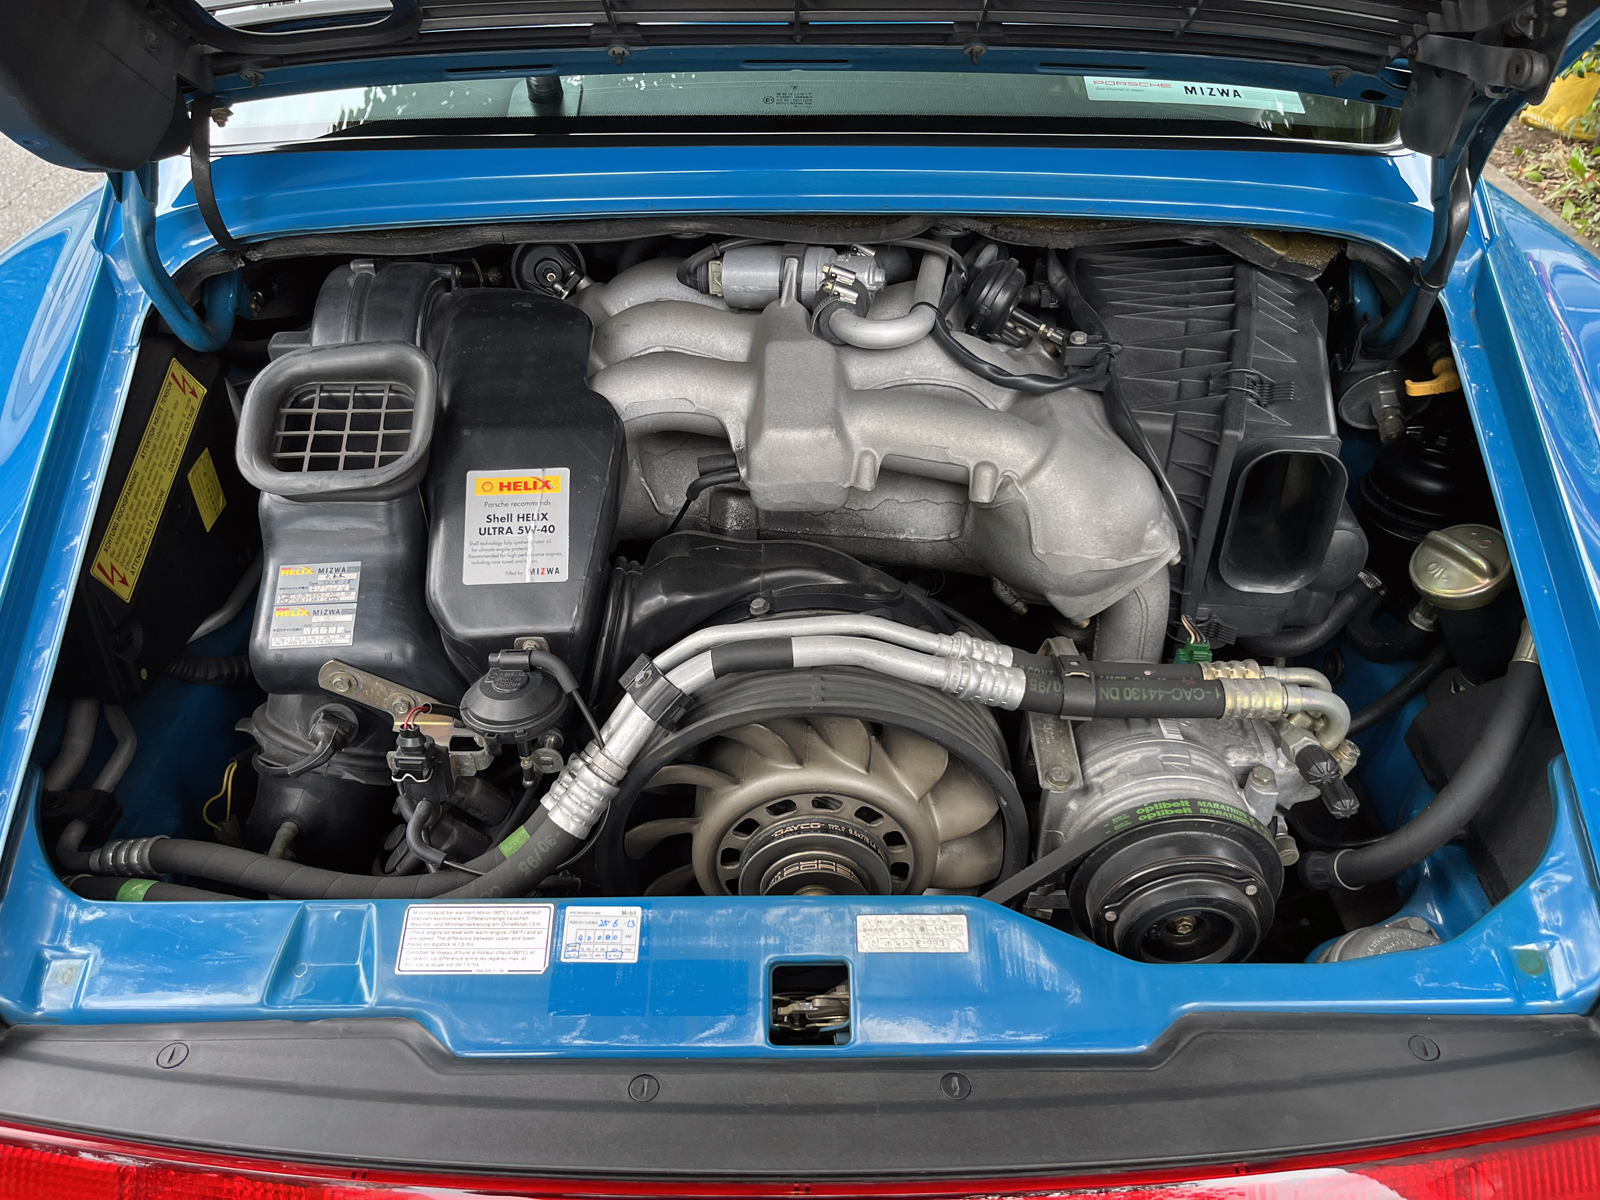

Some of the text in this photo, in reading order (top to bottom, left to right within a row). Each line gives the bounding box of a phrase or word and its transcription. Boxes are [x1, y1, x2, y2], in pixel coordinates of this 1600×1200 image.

[1183, 86, 1242, 98] MIZWA
[139, 380, 173, 460] ATTENTION HAUTE TENSION
[167, 446, 180, 473] DANGER
[177, 431, 186, 448] HIGH
[182, 404, 196, 433] VOLTAGE
[499, 480, 552, 492] HELIX
[102, 520, 119, 554] ACHTUNG
[116, 468, 139, 521] HOCHSPANNUNG
[486, 512, 548, 523] Shell HELIX
[129, 535, 147, 576] ATTENZIONE
[144, 518, 154, 536] ALTA
[150, 487, 165, 519] TENSIONE
[478, 525, 556, 536] ULTRA 5W-40
[281, 568, 314, 576] HELIX
[275, 609, 310, 617] HELIX
[1100, 686, 1119, 700] DN
[1136, 800, 1190, 814] optibelt
[1138, 808, 1193, 820] optibelt
[1197, 801, 1248, 819] MARATHON
[1200, 808, 1250, 826] MARATHON
[774, 822, 820, 837] DAYCO
[612, 919, 618, 927] 6
